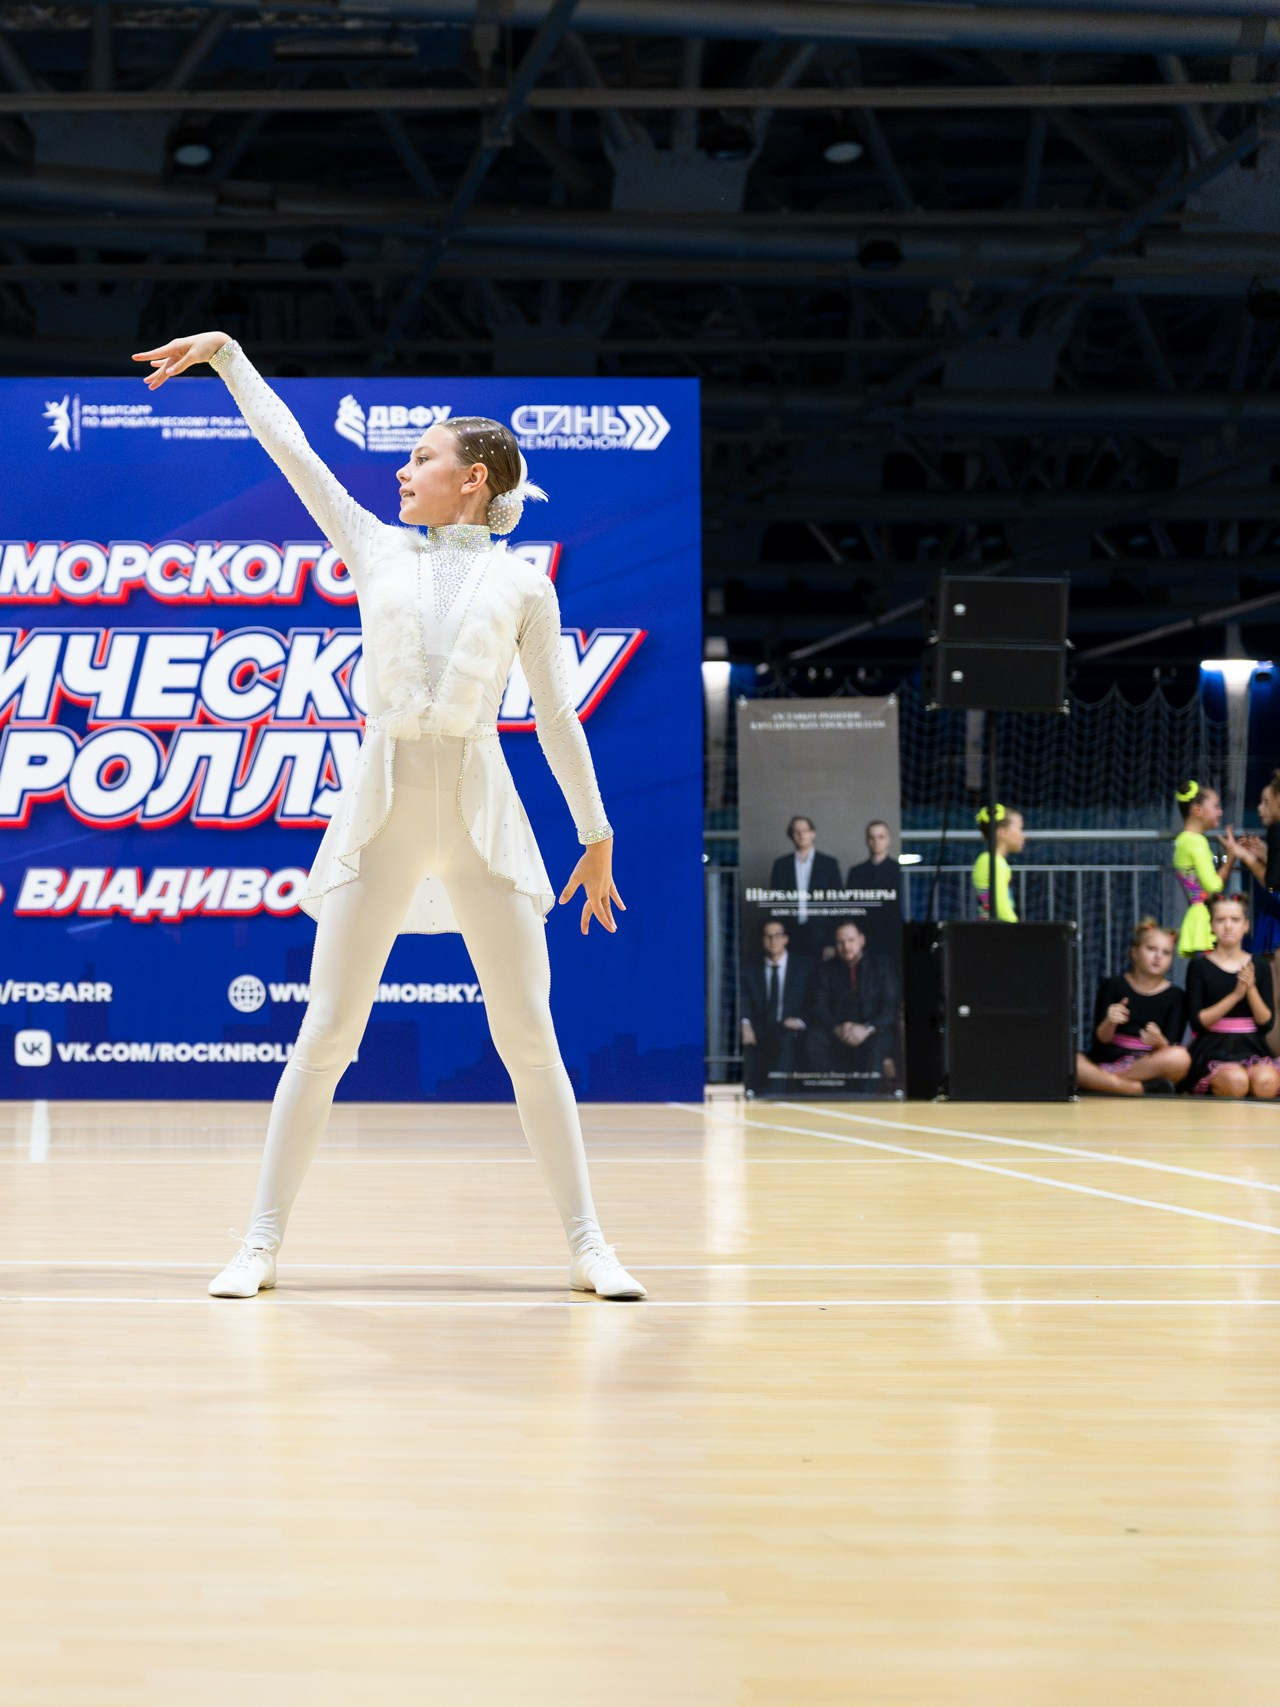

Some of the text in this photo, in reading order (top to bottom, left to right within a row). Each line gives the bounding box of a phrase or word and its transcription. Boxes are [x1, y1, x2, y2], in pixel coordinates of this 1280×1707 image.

[367, 405, 452, 428] ДВФУ
[510, 405, 627, 436] СТАНЬ
[15, 866, 312, 920] ВЛАДИВО
